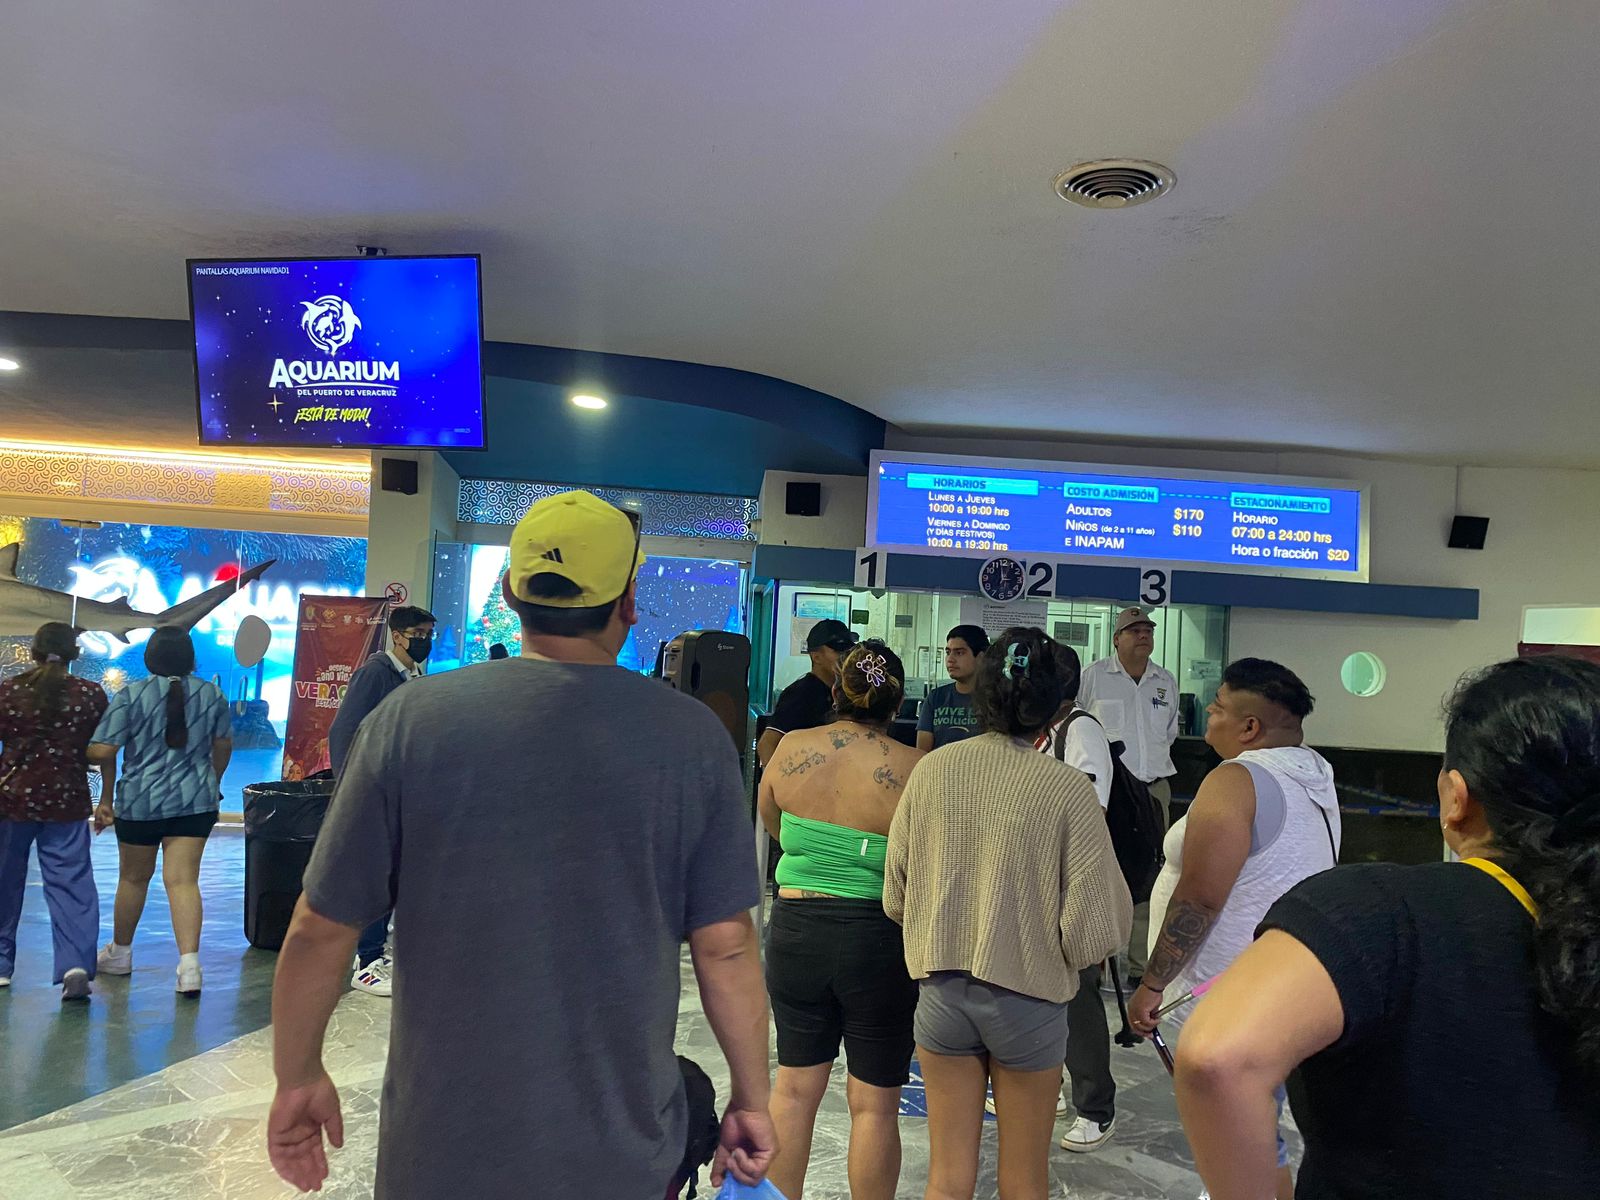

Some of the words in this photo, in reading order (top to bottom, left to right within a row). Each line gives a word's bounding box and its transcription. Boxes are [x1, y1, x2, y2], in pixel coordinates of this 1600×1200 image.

[229, 267, 260, 276] AQUARIUM
[269, 359, 400, 388] AQUARIUM
[357, 389, 397, 397] VERACRUZ
[324, 408, 340, 422] DE
[339, 408, 371, 423] MODA!
[933, 478, 987, 489] HORARIOS
[928, 491, 955, 502] LUNES
[965, 494, 996, 504] JUEVES
[1067, 486, 1100, 496] COSTO
[1103, 488, 1155, 500] ADMISIÓN
[928, 503, 955, 513] 10:00
[957, 506, 963, 514] a
[966, 506, 992, 515] 19:00
[994, 507, 1010, 516] hrs
[1233, 497, 1328, 511] ESTACIONAMIENTO
[1066, 503, 1112, 517] ADULTOS
[1174, 507, 1205, 521] $170
[1233, 511, 1278, 525] HORARIO
[927, 517, 962, 528] VIERNES
[971, 519, 1011, 531] DOMINGO
[1065, 519, 1098, 532] NIÑOS
[1101, 525, 1113, 534] (de
[1135, 527, 1156, 536] años)
[1172, 524, 1203, 537] $110
[926, 528, 935, 537] (Y
[935, 528, 954, 537] DÍAS
[955, 529, 996, 540] FESTIVOS)
[1231, 527, 1266, 539] 07:00
[1268, 531, 1276, 540] a
[1278, 529, 1312, 542] 24:00
[1313, 531, 1333, 543] hrs
[927, 538, 953, 548] 10:00
[955, 541, 962, 549] a
[964, 540, 991, 550] 19:30
[993, 541, 1009, 551] hrs
[1065, 538, 1072, 547] E
[1075, 535, 1125, 549] INAPAM
[1231, 544, 1260, 557] Hora
[1262, 548, 1271, 557] o
[1273, 546, 1319, 560] fracción
[1327, 548, 1350, 561] $20
[861, 552, 877, 587] 1
[1028, 562, 1053, 597] 2
[1141, 569, 1167, 605] 3
[295, 681, 348, 701] VERAC
